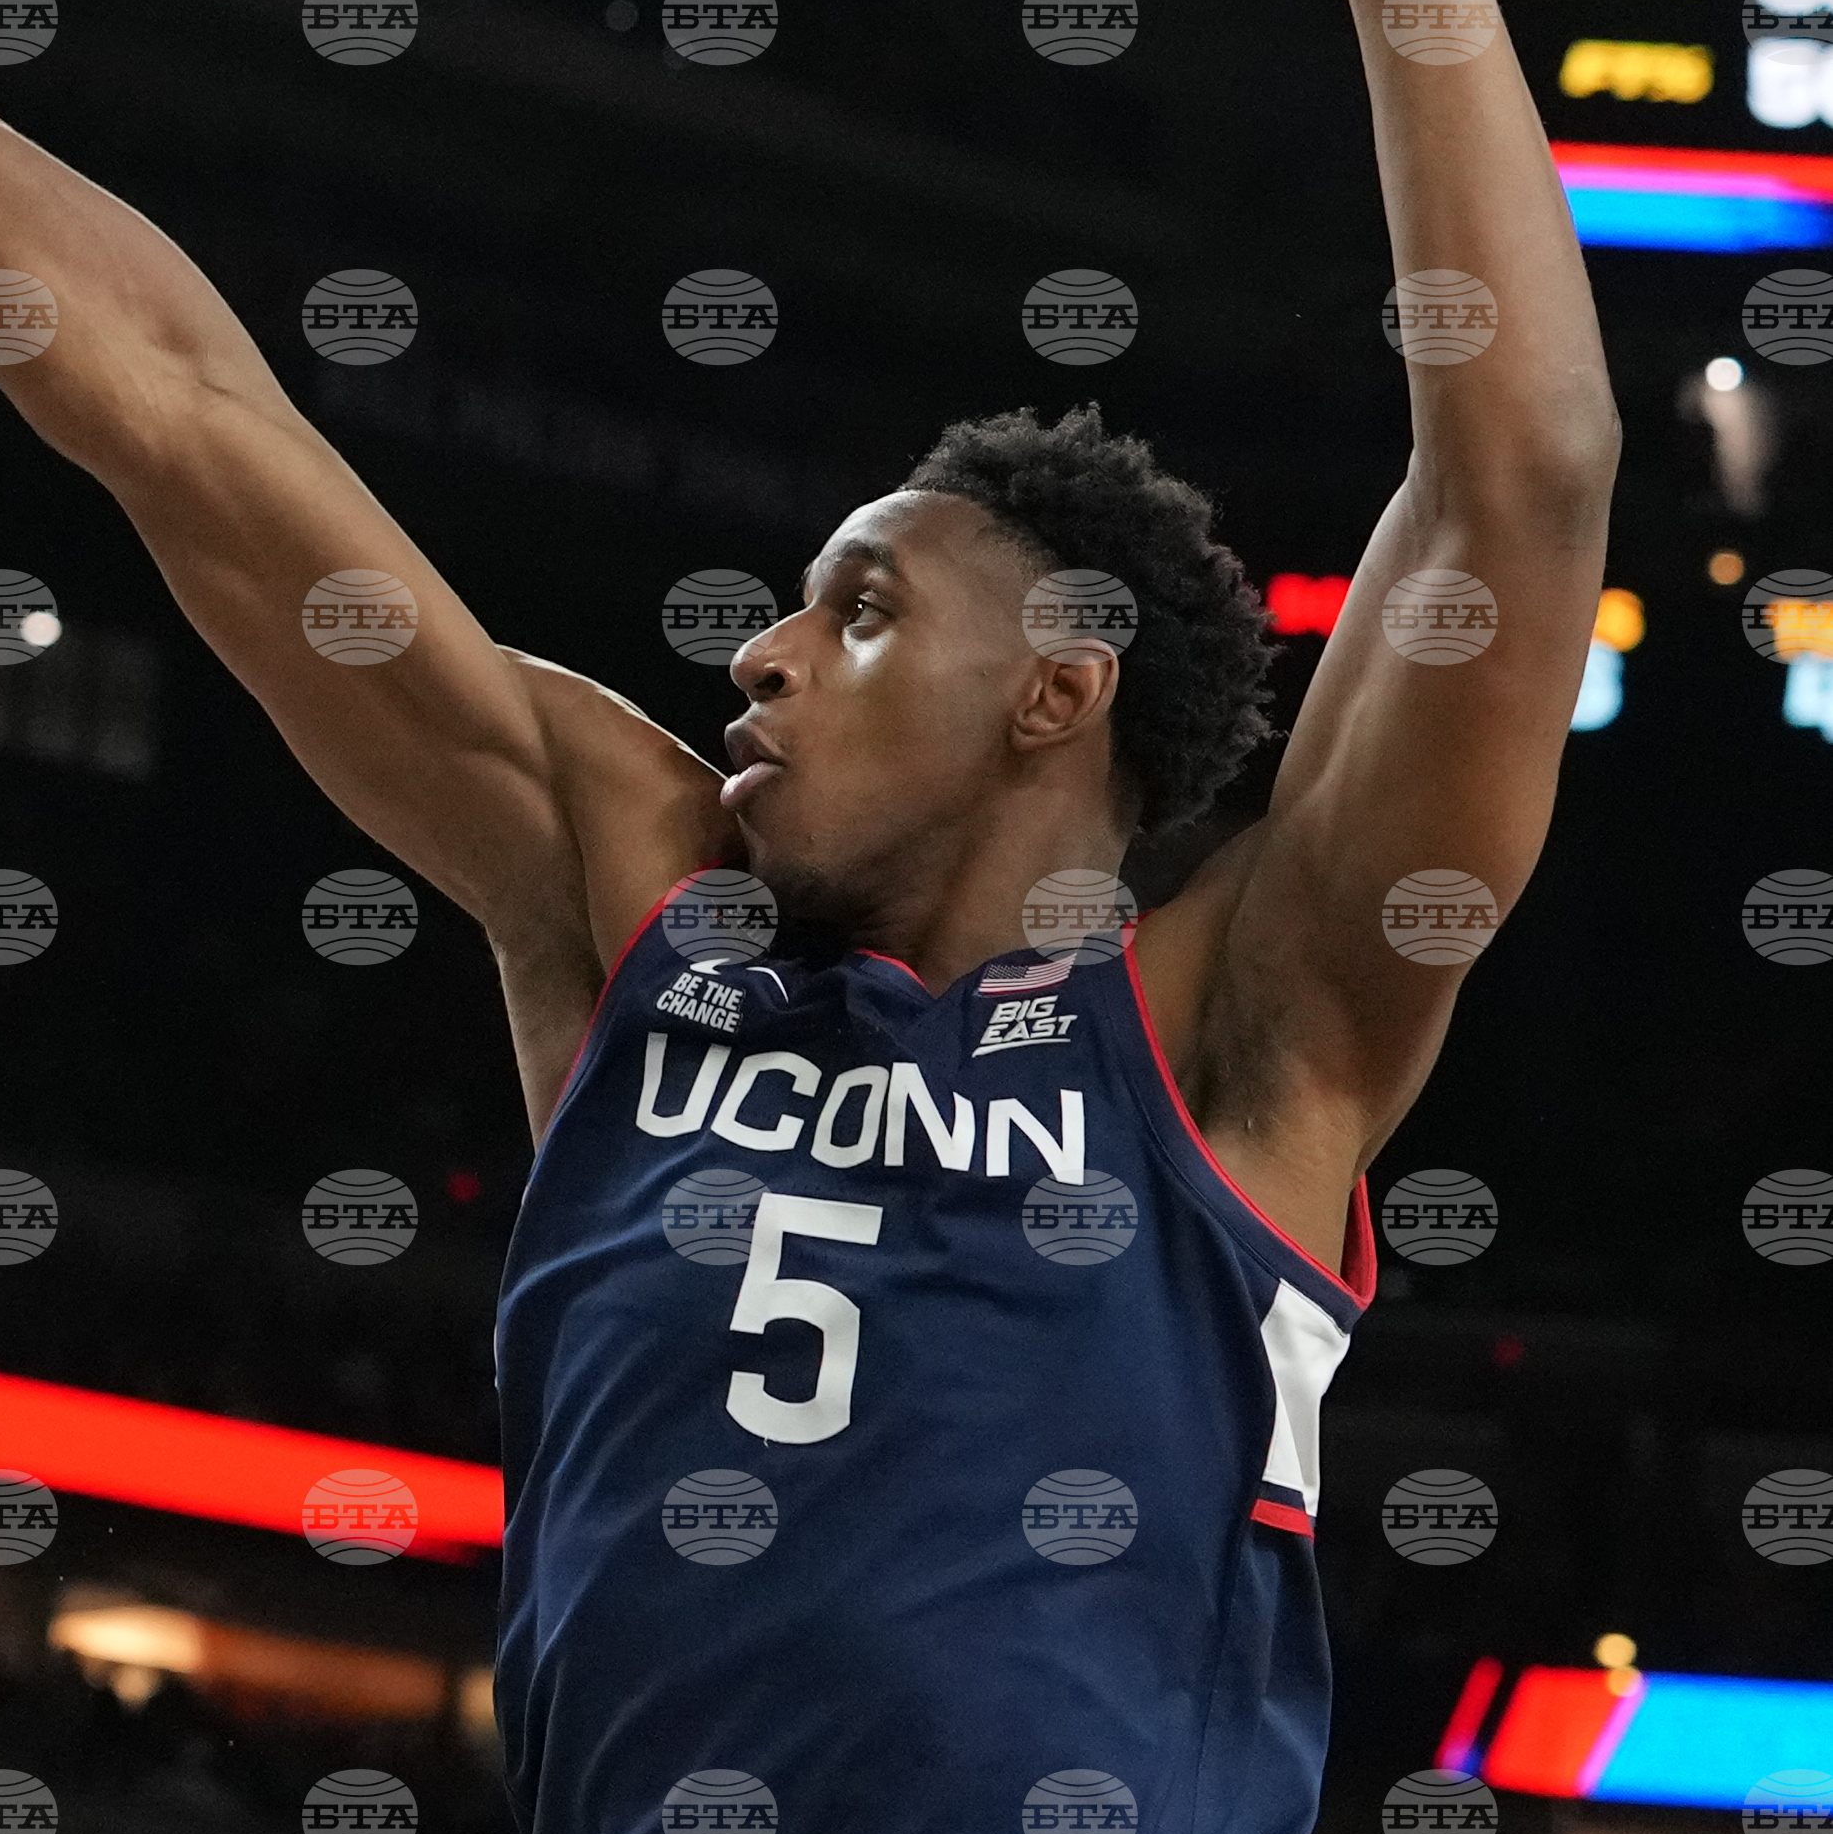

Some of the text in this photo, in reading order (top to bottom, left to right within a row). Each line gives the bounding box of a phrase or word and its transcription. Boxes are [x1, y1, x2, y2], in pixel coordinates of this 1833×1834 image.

[656, 990, 740, 1033] CHANGE
[672, 972, 743, 1011] BE THE
[989, 995, 1058, 1024] BIG
[980, 1014, 1078, 1044] EAST
[635, 1031, 1086, 1186] UCONN
[726, 1192, 883, 1446] 5
